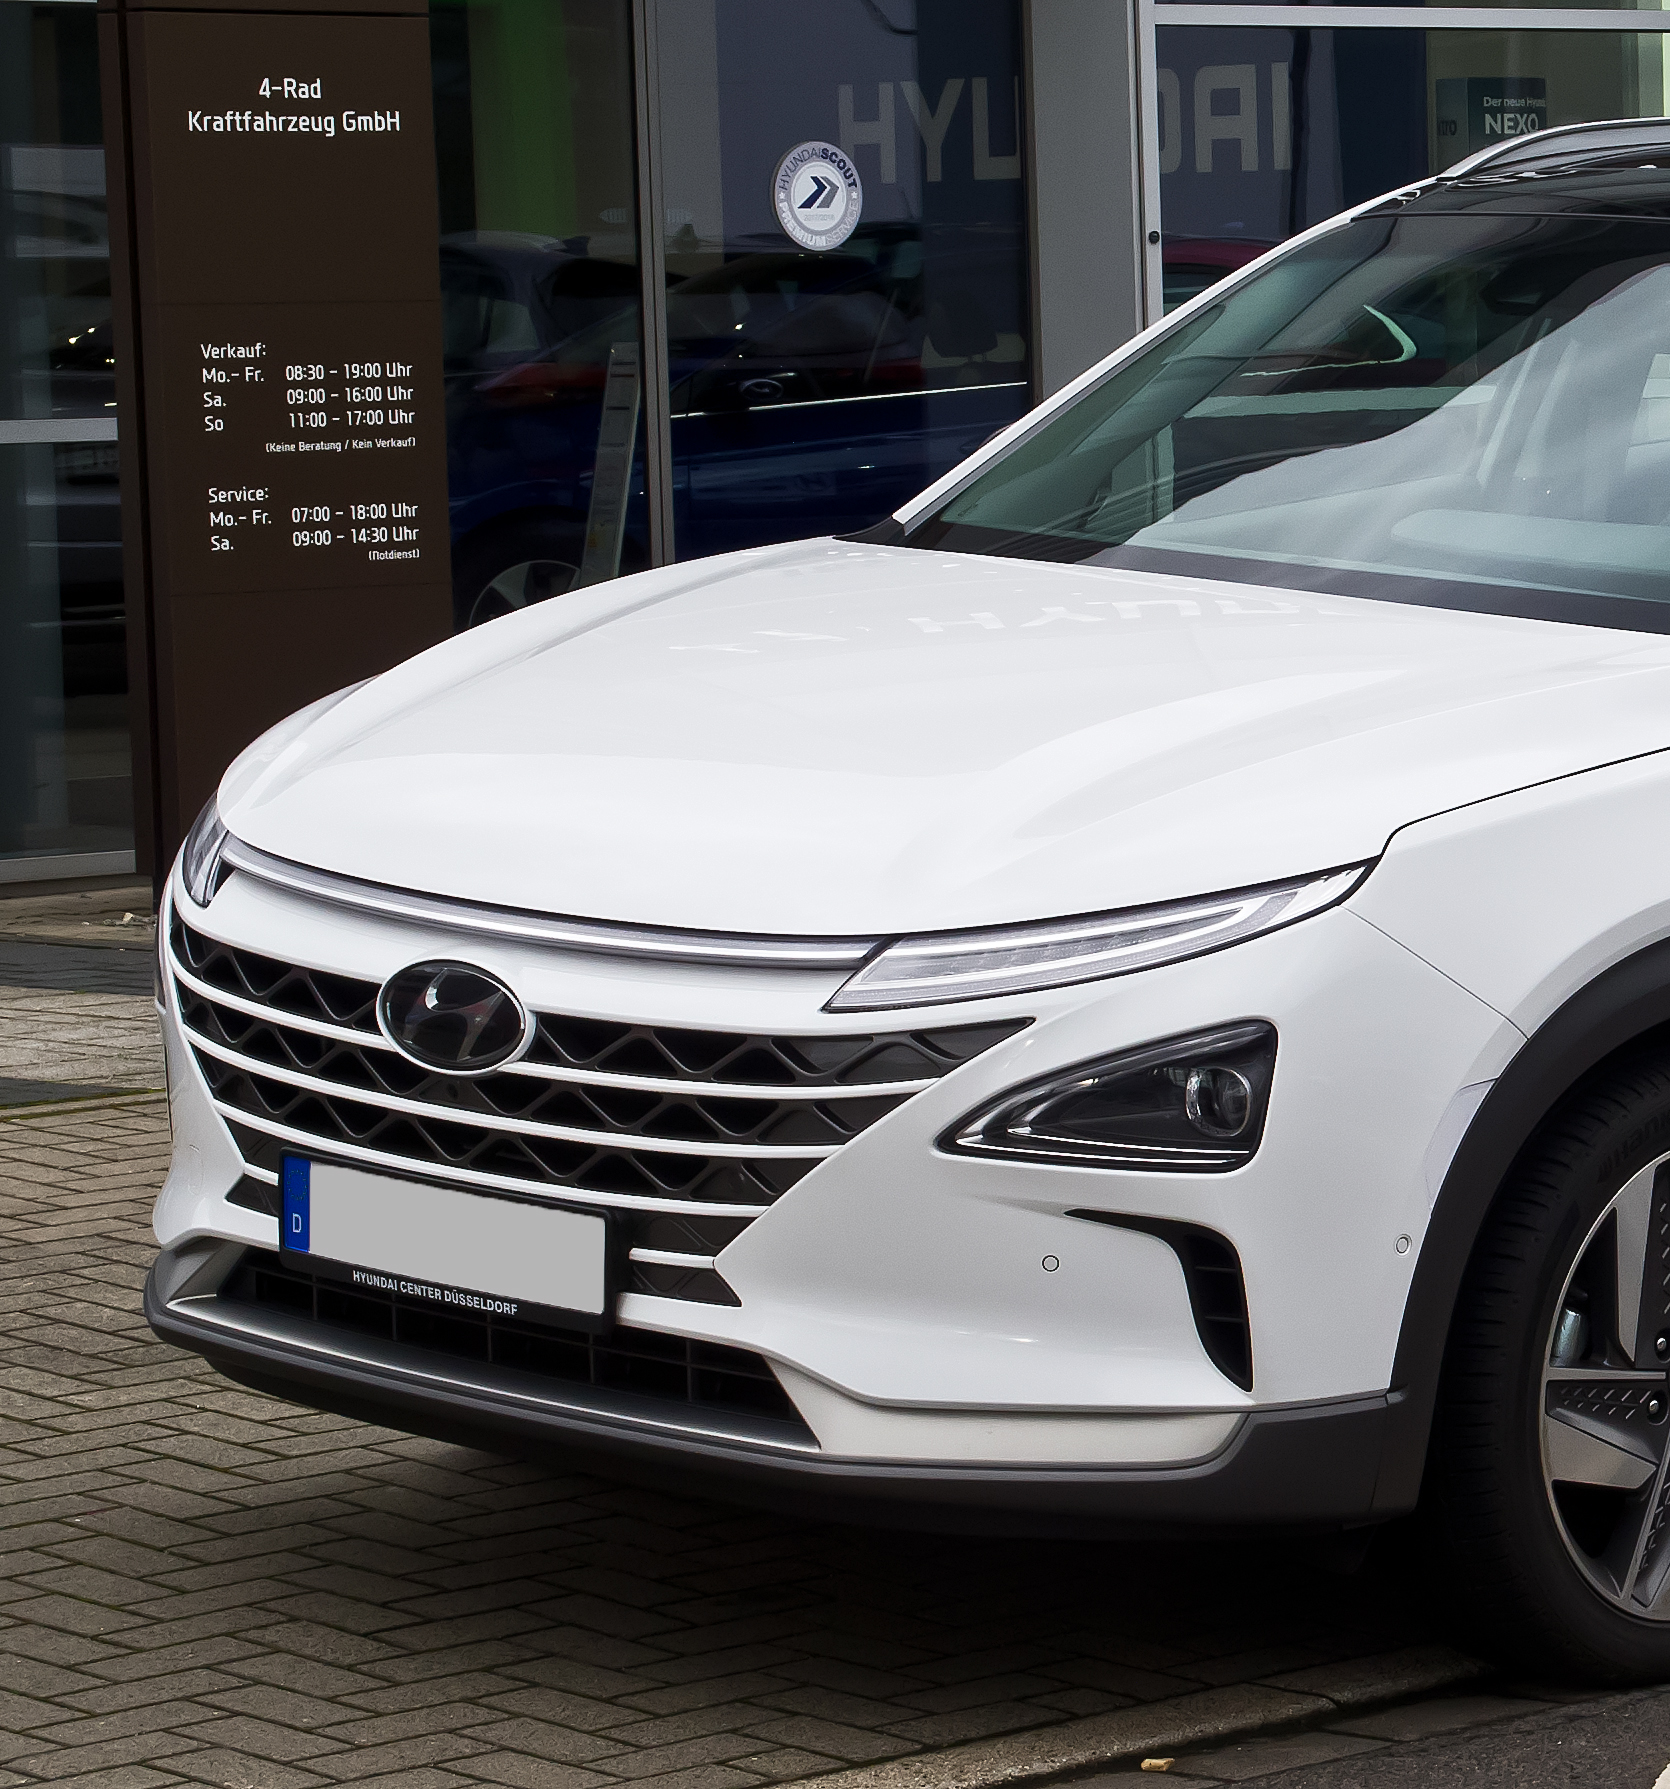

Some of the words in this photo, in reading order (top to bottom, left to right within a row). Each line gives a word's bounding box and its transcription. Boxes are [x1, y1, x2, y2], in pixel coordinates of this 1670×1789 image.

[259, 78, 321, 98] 4-Rad
[1484, 97, 1502, 107] Der
[188, 111, 335, 137] Kraftfahrzeug
[343, 111, 400, 131] GmbH
[1485, 113, 1539, 135] NEXO
[201, 342, 266, 359] Verkauf:
[203, 368, 239, 383] Mo.-
[245, 367, 264, 382] Fr.
[286, 365, 324, 380] 08:30
[344, 363, 381, 379] 19:00
[386, 362, 413, 377] Uhr
[204, 392, 226, 407] Sa.
[287, 388, 325, 404] 09:00
[345, 386, 382, 402] 16:00
[387, 386, 413, 400] Uhr
[205, 416, 223, 431] So
[289, 412, 326, 428] 11:00
[347, 410, 383, 425] 17:00
[389, 409, 415, 424] Uhr
[266, 442, 295, 452] (Keine
[299, 441, 341, 452] Beratung
[352, 439, 372, 449] Kein
[375, 437, 415, 447] Verkauf)
[209, 486, 269, 503] Service:
[210, 512, 246, 527] Mo.-
[253, 510, 271, 525] Fr.
[292, 506, 330, 523] 07:00
[350, 504, 387, 520] 18:00
[392, 503, 418, 517] Uhr
[211, 536, 234, 551] Sa.
[293, 530, 331, 546] 09:00
[351, 527, 387, 543] 14:30
[393, 526, 419, 541] Uhr
[369, 548, 419, 560] (Notdienst)
[293, 1213, 301, 1233] D
[353, 1270, 398, 1291] HYUNDAI
[400, 1281, 442, 1301] CENTER
[444, 1289, 518, 1316] DÜSSELDORF
